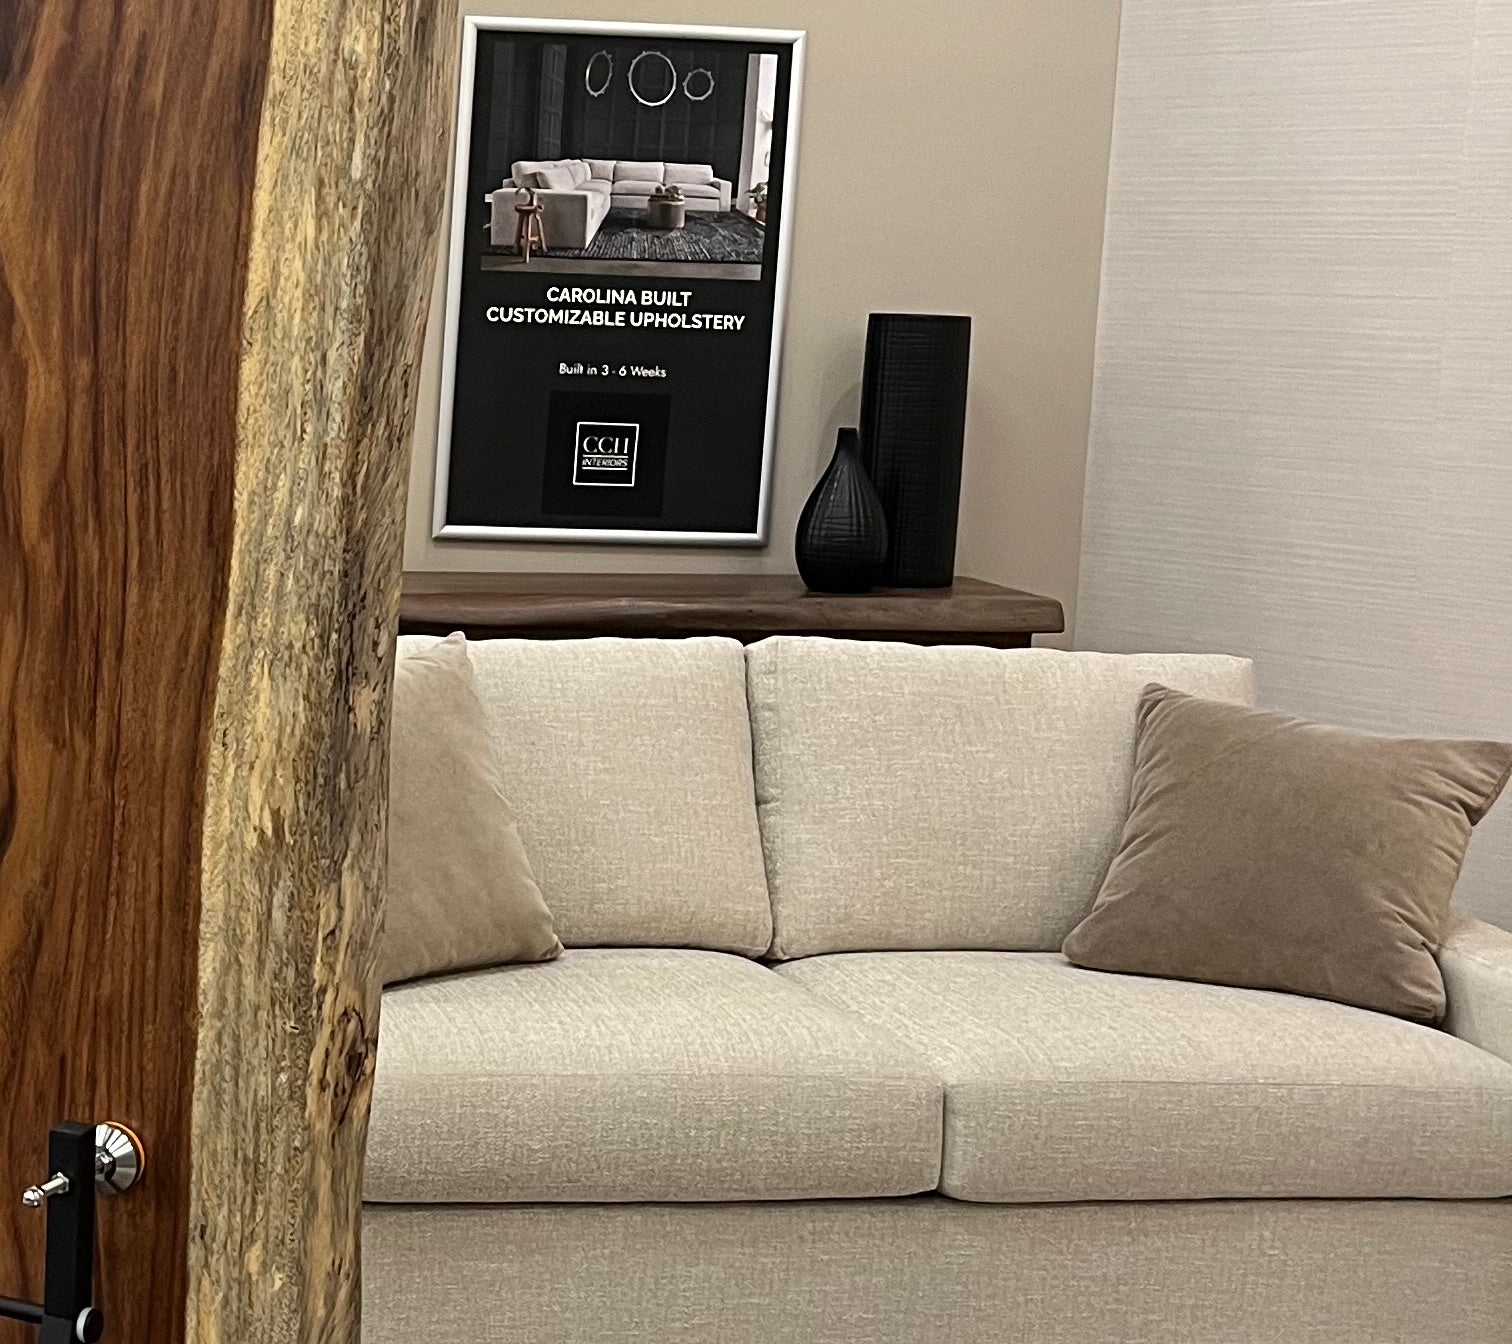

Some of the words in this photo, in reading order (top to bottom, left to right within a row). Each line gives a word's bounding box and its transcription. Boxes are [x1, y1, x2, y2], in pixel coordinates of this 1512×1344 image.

[546, 286, 637, 305] CAROLINA
[641, 289, 692, 307] BUILT
[486, 306, 626, 327] CUSTOMIZABLE
[630, 311, 745, 330] UPHOLSTERY
[559, 362, 584, 375] Built
[587, 363, 597, 376] in
[601, 364, 609, 376] 3
[618, 365, 627, 377] 6
[630, 366, 667, 378] Weeks
[583, 436, 629, 454] CCH
[581, 458, 629, 467] INTERIORS
